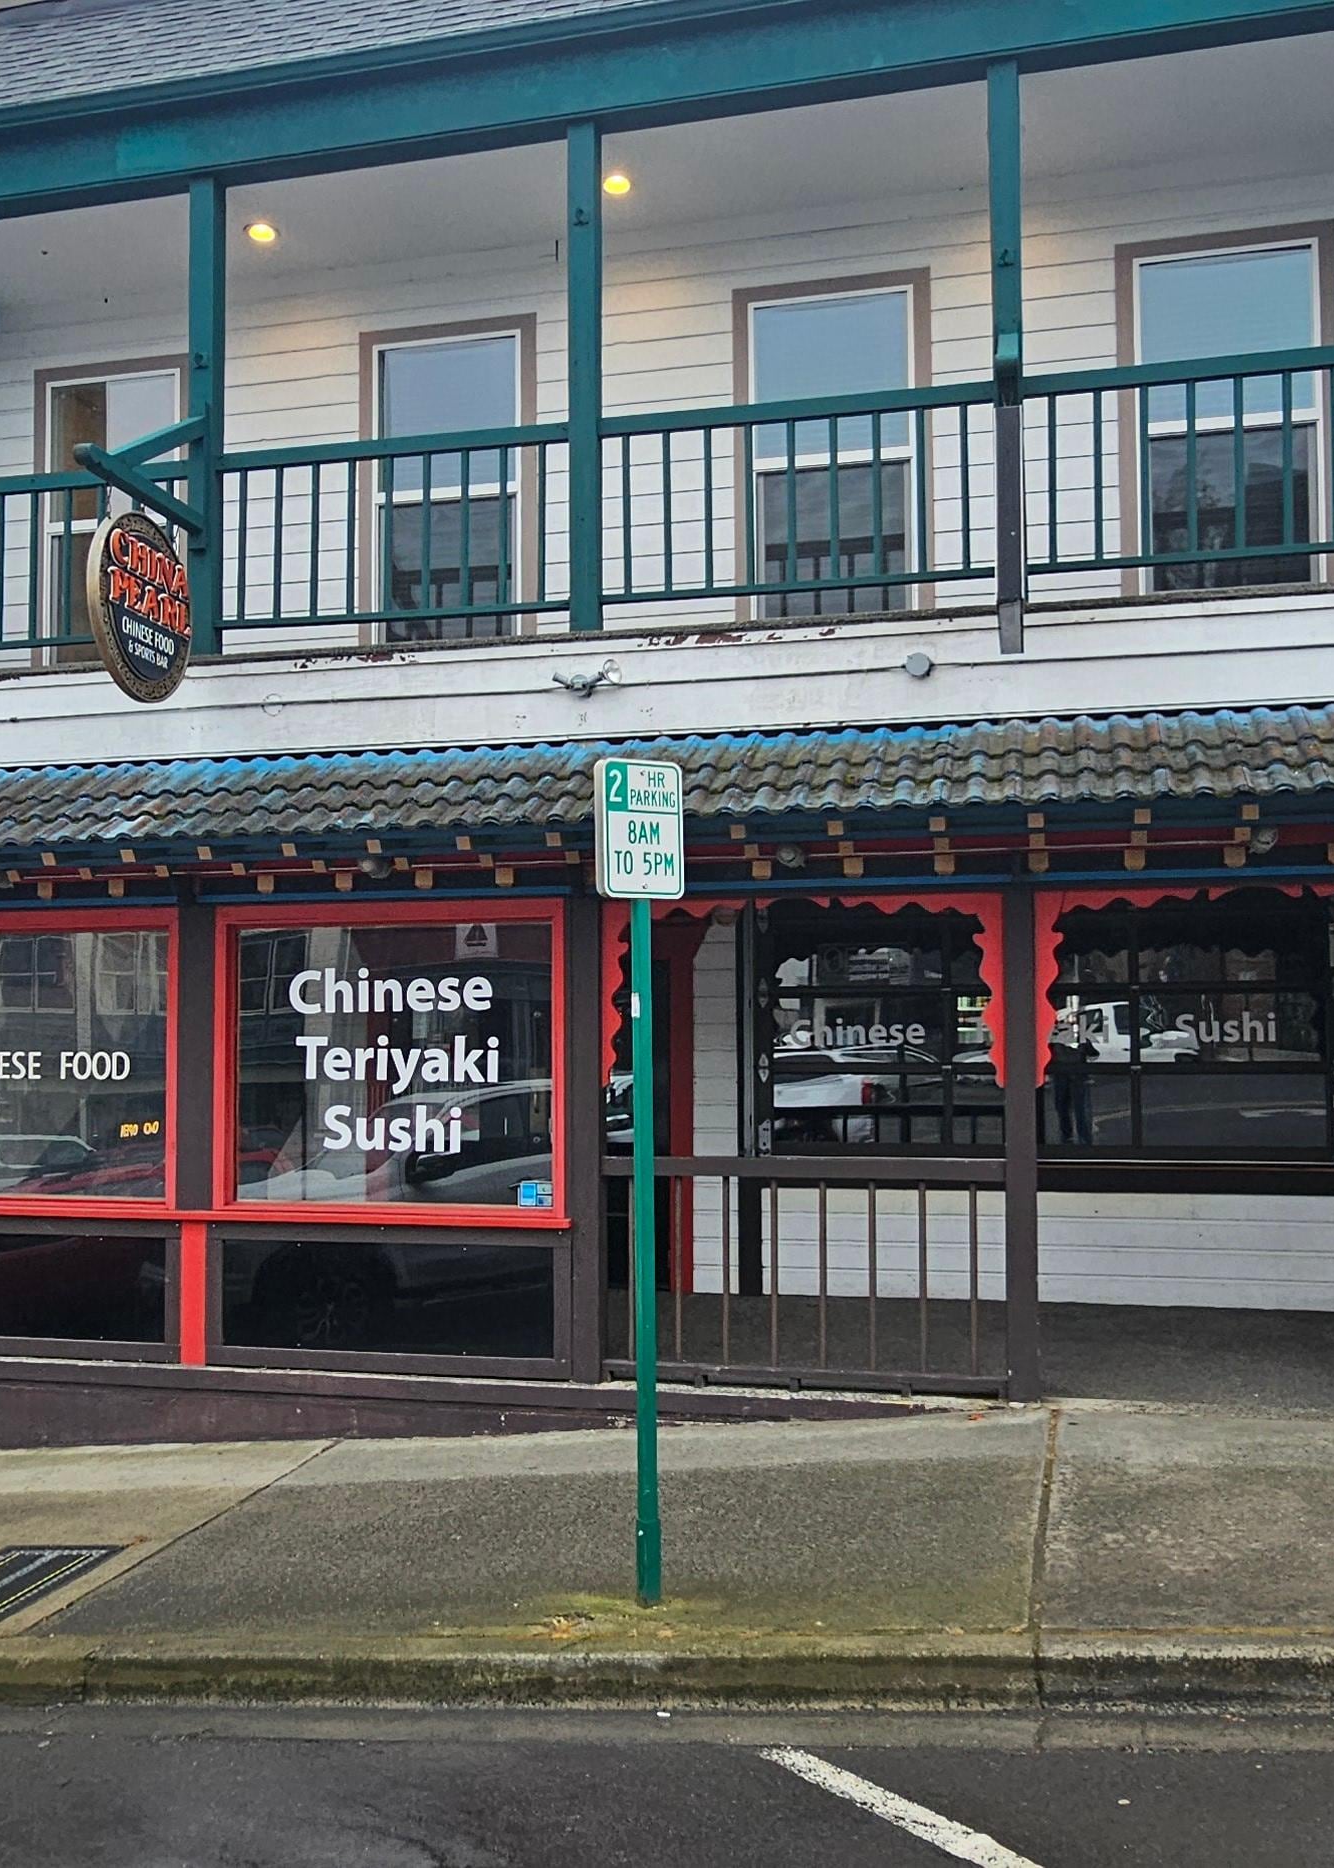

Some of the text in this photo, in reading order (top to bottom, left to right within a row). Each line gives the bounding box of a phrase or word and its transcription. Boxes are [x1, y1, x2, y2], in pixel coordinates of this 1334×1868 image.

[109, 528, 188, 600] CHINA
[107, 566, 191, 640] PEARL
[122, 616, 175, 655] CHINESE FOOD
[128, 641, 168, 670] & SPORTS BAR
[609, 769, 665, 802] 2 HR
[630, 789, 676, 808] PARKING
[628, 820, 660, 845] 8AM
[614, 850, 675, 876] TO 5PM
[289, 968, 492, 1015] Chinese
[790, 1017, 926, 1048] Chinese
[1175, 1011, 1277, 1044] Sushi
[60, 1051, 131, 1081] FOOD
[296, 1035, 499, 1094] Teriyaki
[323, 1105, 462, 1153] Sushi
